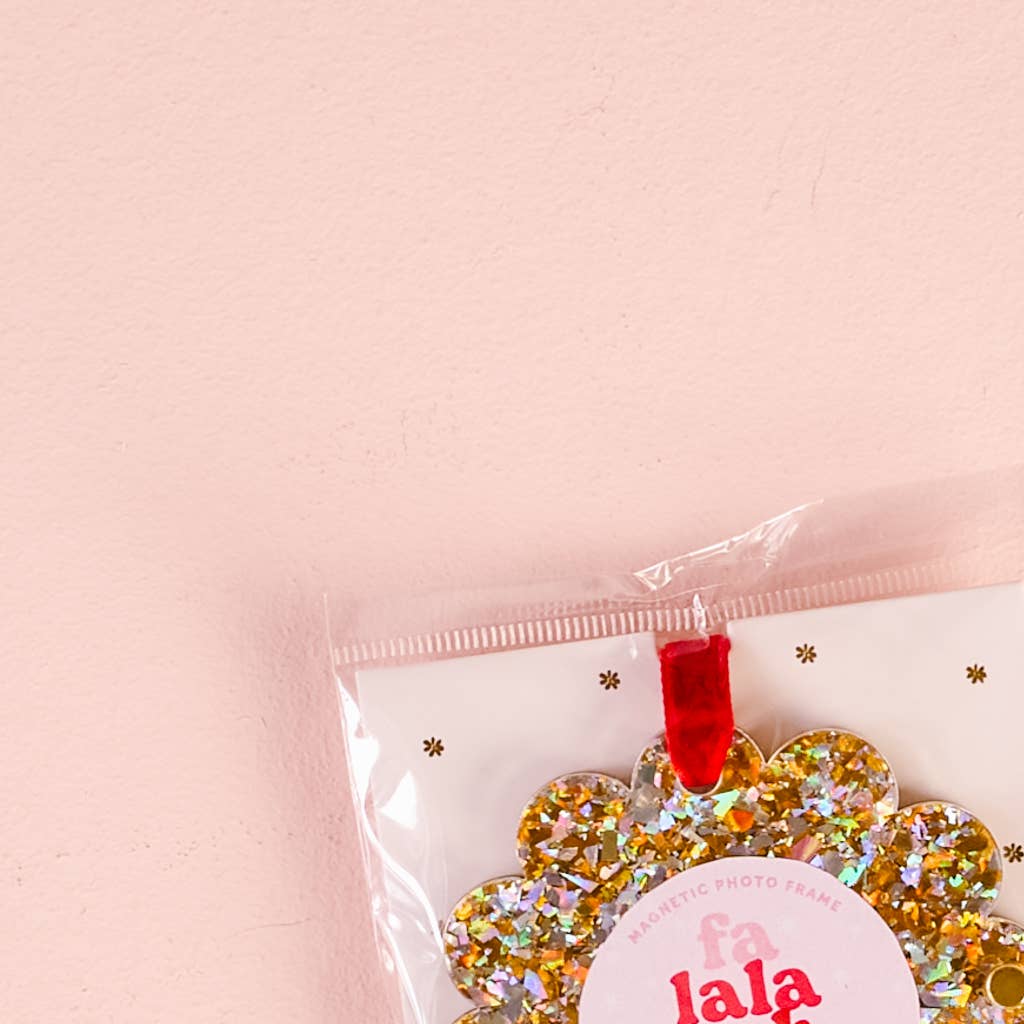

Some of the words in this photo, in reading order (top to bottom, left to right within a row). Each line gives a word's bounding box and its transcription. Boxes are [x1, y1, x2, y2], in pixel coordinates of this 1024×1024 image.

[627, 882, 709, 945] MAGNETIC
[715, 874, 778, 891] PHOTO
[785, 879, 843, 913] FRAME
[698, 911, 780, 970] fa
